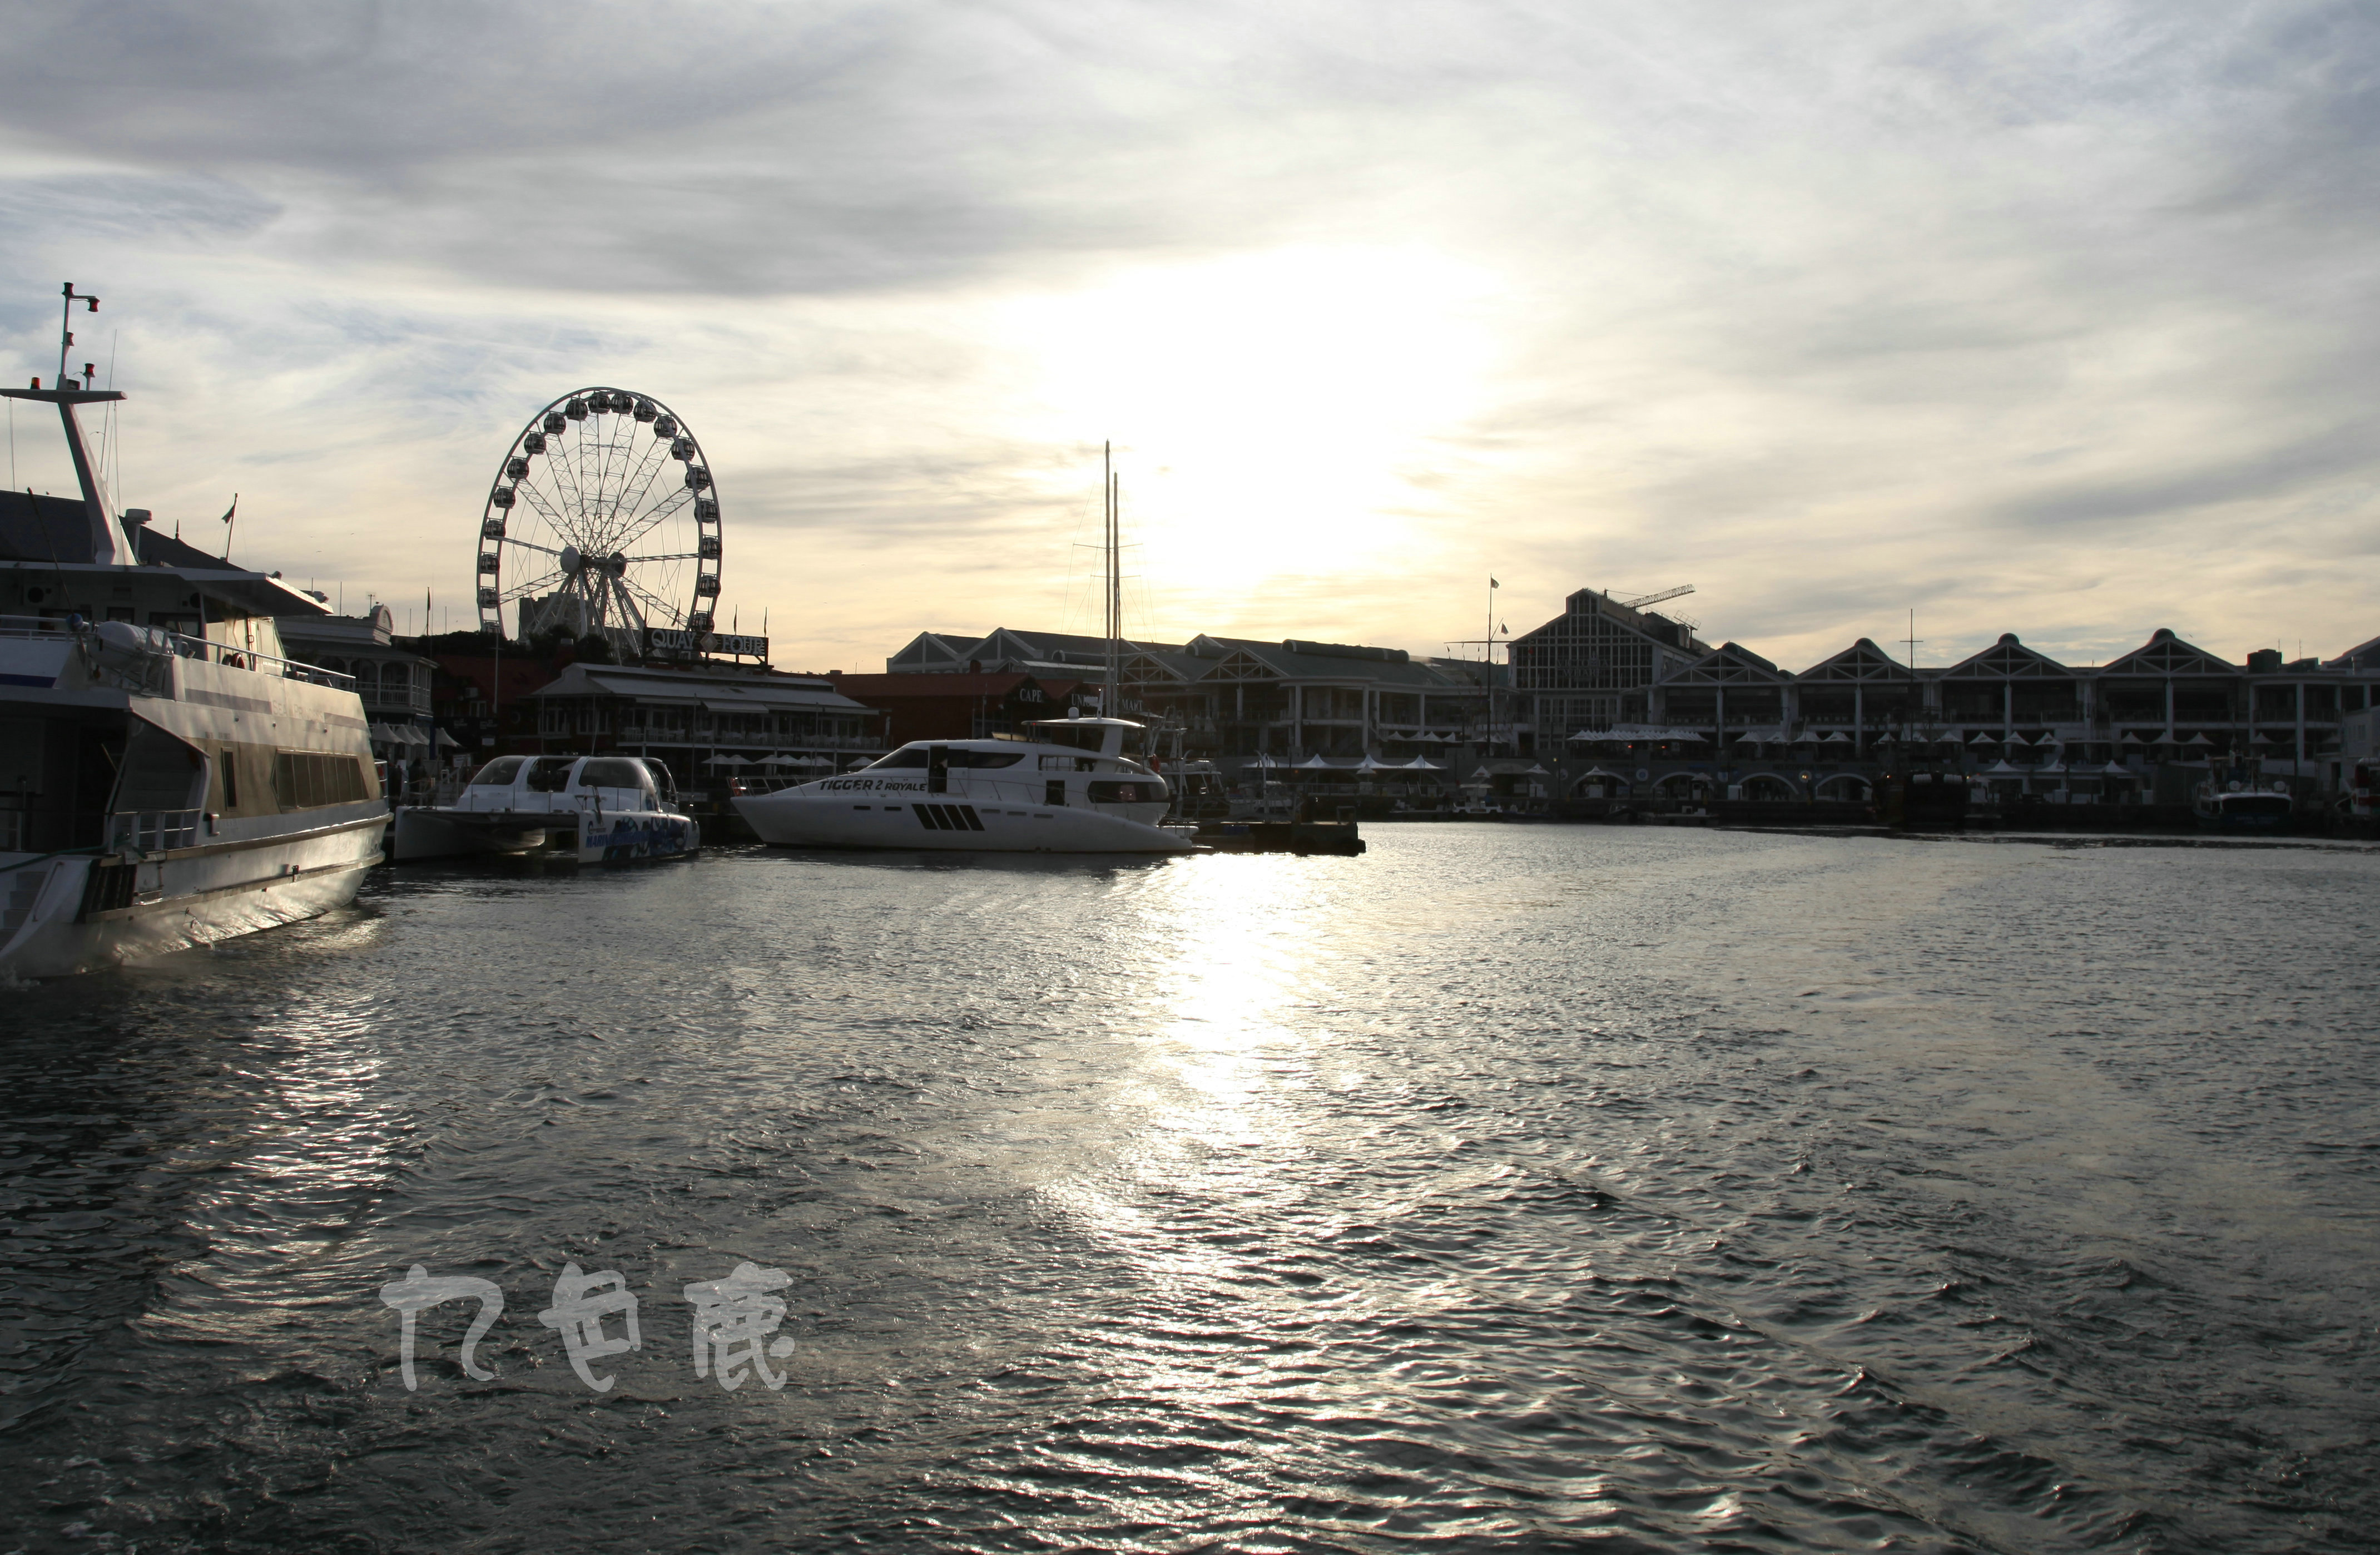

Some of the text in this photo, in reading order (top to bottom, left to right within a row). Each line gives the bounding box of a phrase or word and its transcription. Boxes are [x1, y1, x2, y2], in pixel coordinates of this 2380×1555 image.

[651, 629, 764, 655] QUAY FOUR
[1557, 659, 1609, 667] VICTOIA
[1019, 689, 1043, 703] CAPE
[1122, 699, 1143, 711] MART
[820, 780, 927, 791] TIGGER 2 ROYALE
